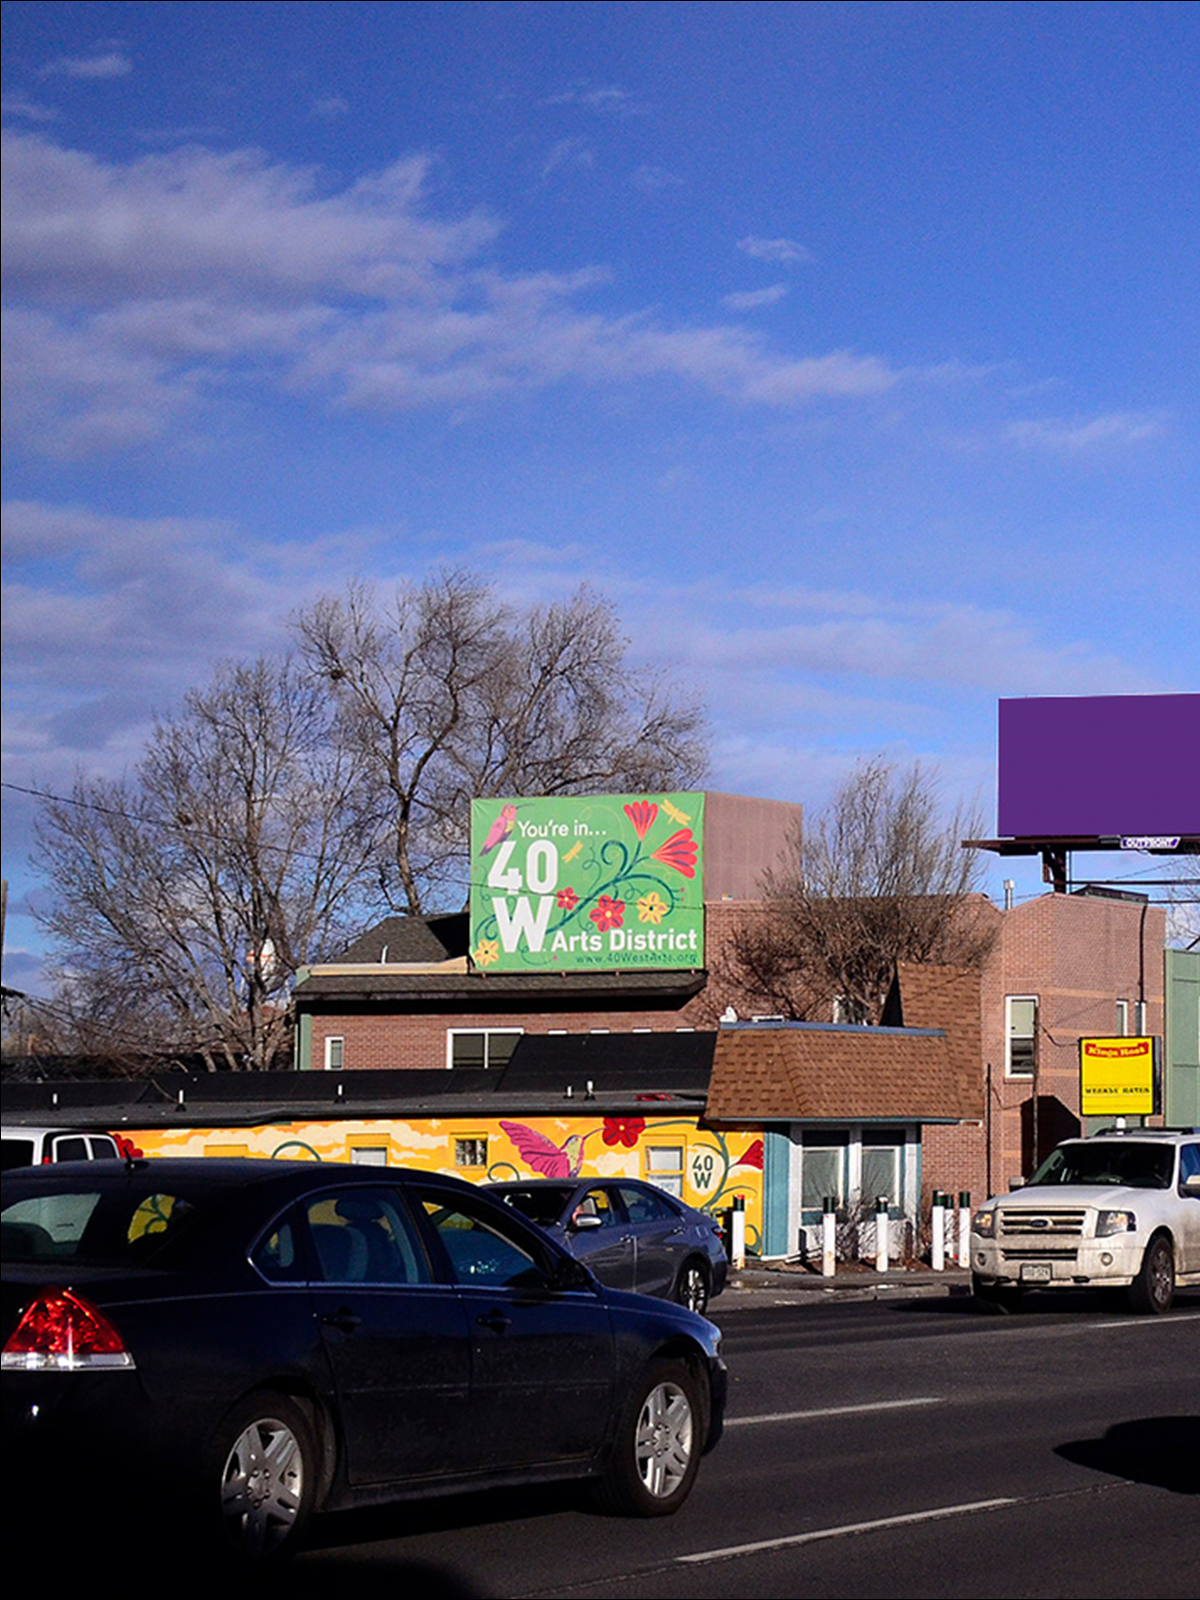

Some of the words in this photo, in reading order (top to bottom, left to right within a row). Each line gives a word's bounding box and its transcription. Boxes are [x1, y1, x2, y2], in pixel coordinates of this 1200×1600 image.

[517, 820, 569, 838] You're
[573, 820, 607, 837] in...
[487, 839, 558, 895] 40
[491, 896, 554, 953] W
[551, 930, 603, 952] Arts
[609, 928, 698, 951] District
[576, 951, 697, 966] www.40WestArts.org
[692, 1154, 714, 1172] 40
[694, 1171, 712, 1189] W
